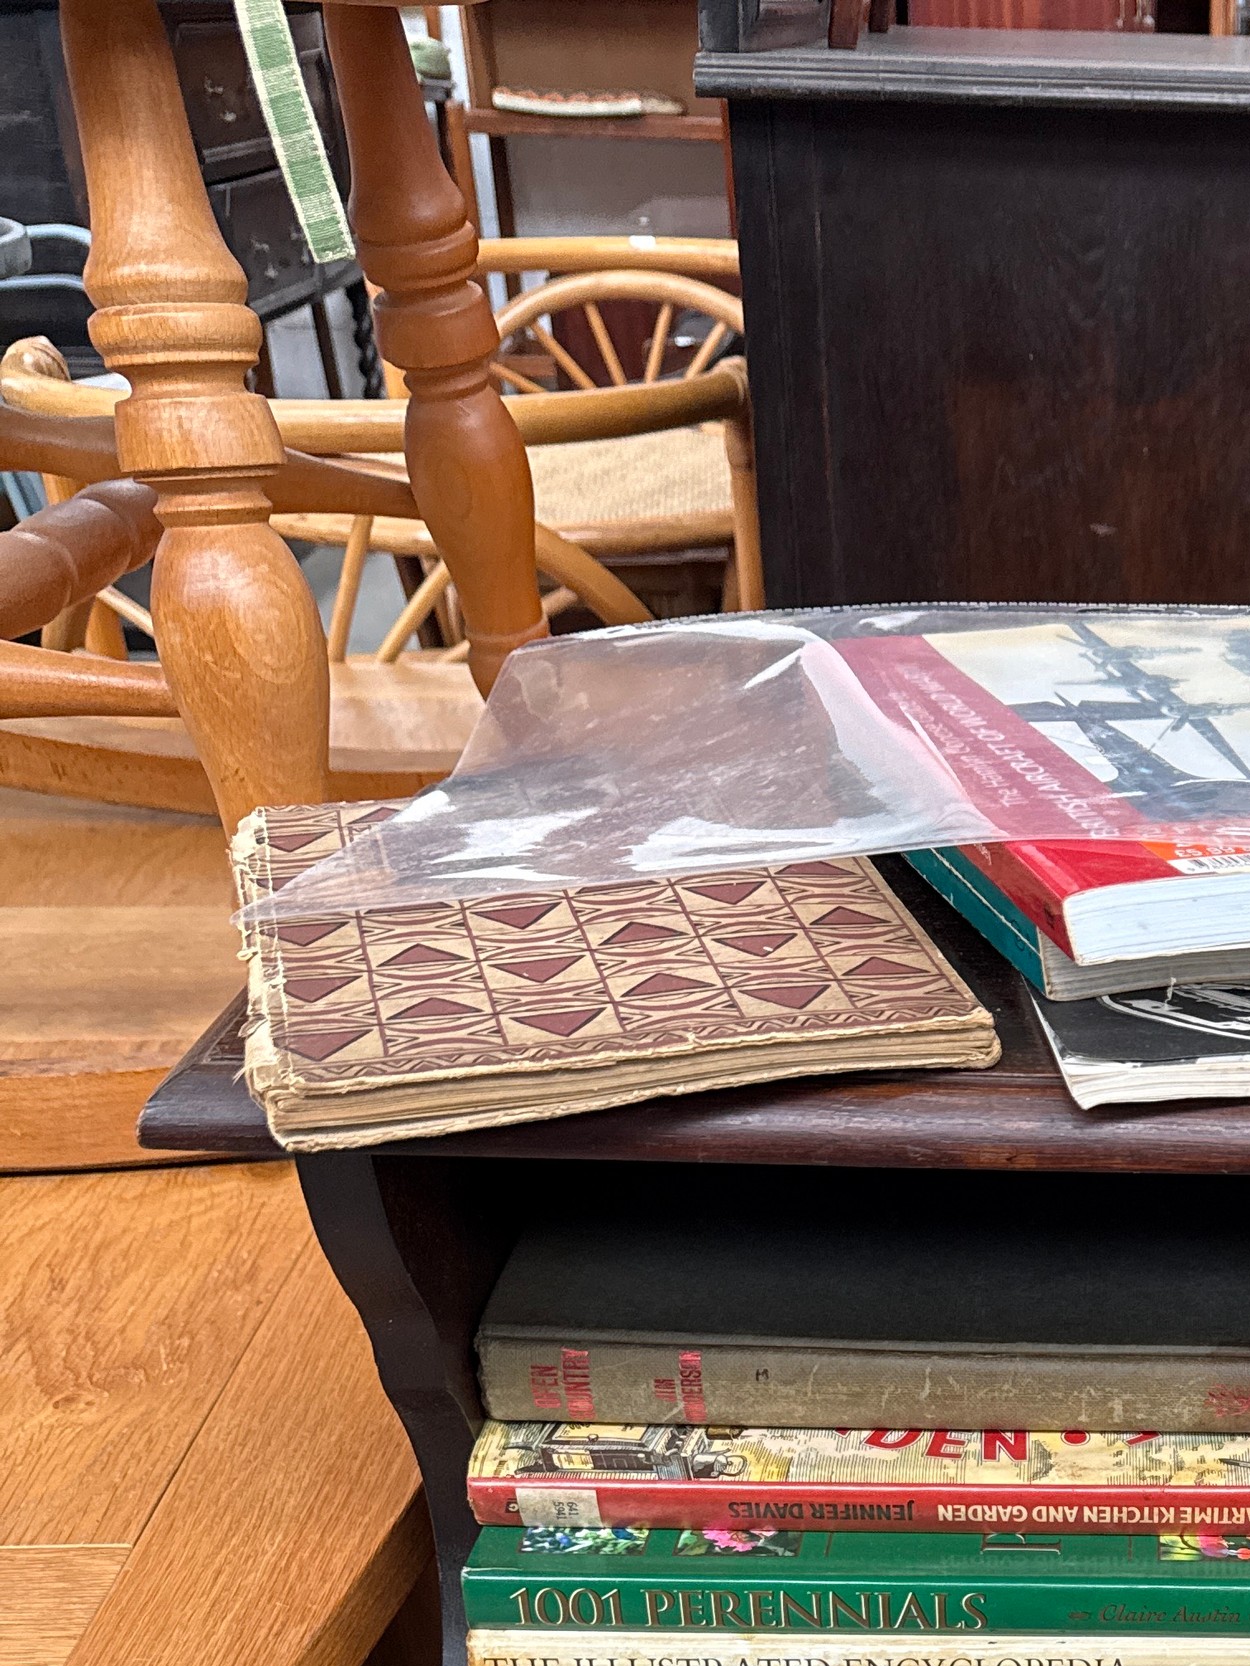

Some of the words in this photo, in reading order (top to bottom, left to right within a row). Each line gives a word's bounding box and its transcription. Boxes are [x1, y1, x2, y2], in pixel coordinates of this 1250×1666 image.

[987, 743, 1068, 792] AIRCRAFT
[552, 1500, 565, 1521] 5941
[728, 1501, 804, 1520] DAVIES
[811, 1500, 916, 1521] JENNIFER
[936, 1503, 1029, 1523] GARDEN
[1031, 1504, 1077, 1524] AND
[1082, 1505, 1176, 1525] KITCHEN
[509, 1587, 623, 1627] 1001
[642, 1588, 988, 1630] PERENNIALS
[1098, 1602, 1168, 1623] Claire
[1172, 1604, 1241, 1624] Austin
